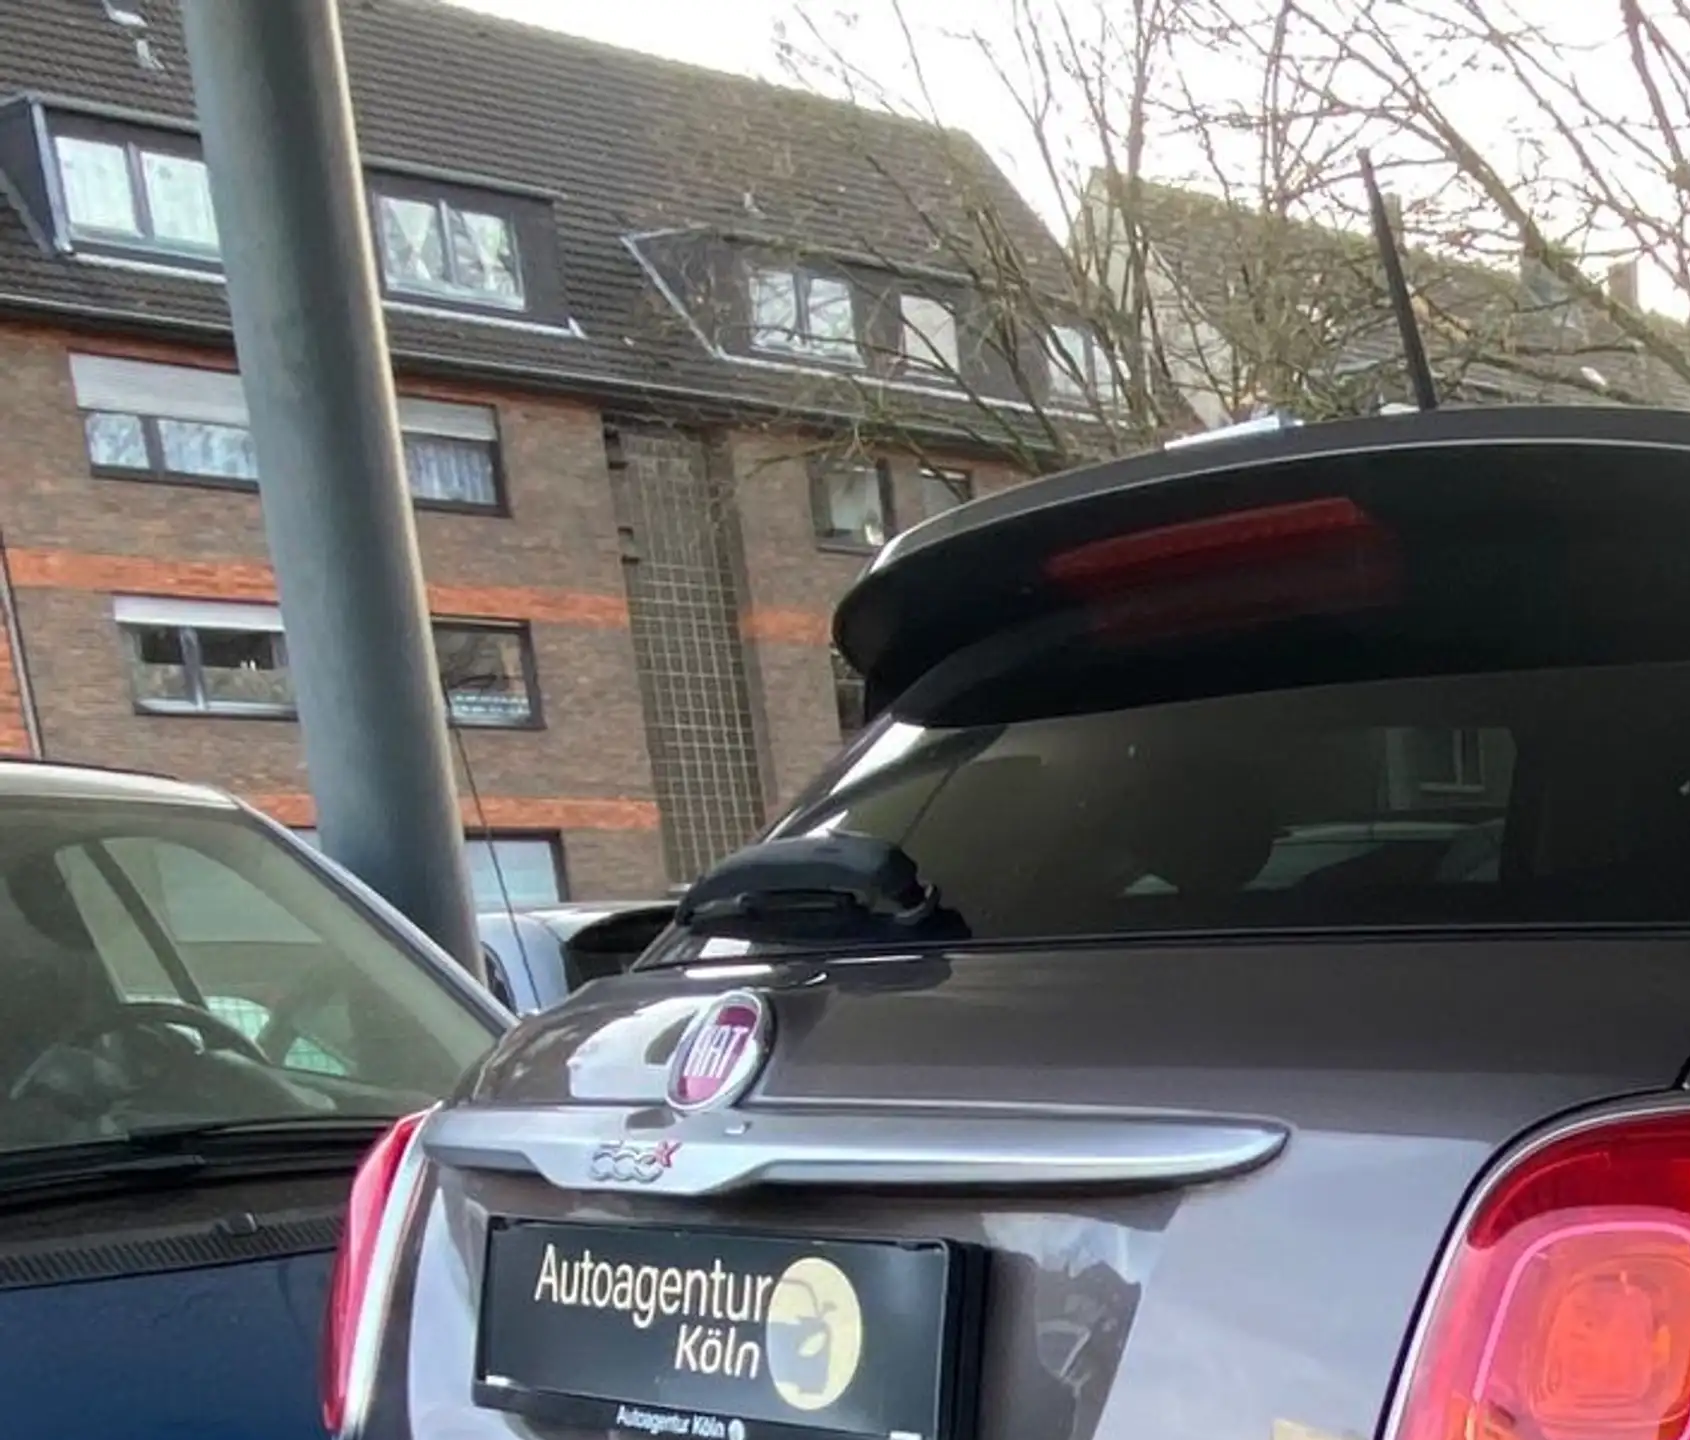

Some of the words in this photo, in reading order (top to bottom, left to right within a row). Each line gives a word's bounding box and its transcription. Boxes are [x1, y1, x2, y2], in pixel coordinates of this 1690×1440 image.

[683, 1024, 749, 1078] FIAT
[533, 1242, 774, 1329] Autoagentur
[674, 1323, 760, 1380] Köln
[616, 1404, 690, 1435] Autoagentur
